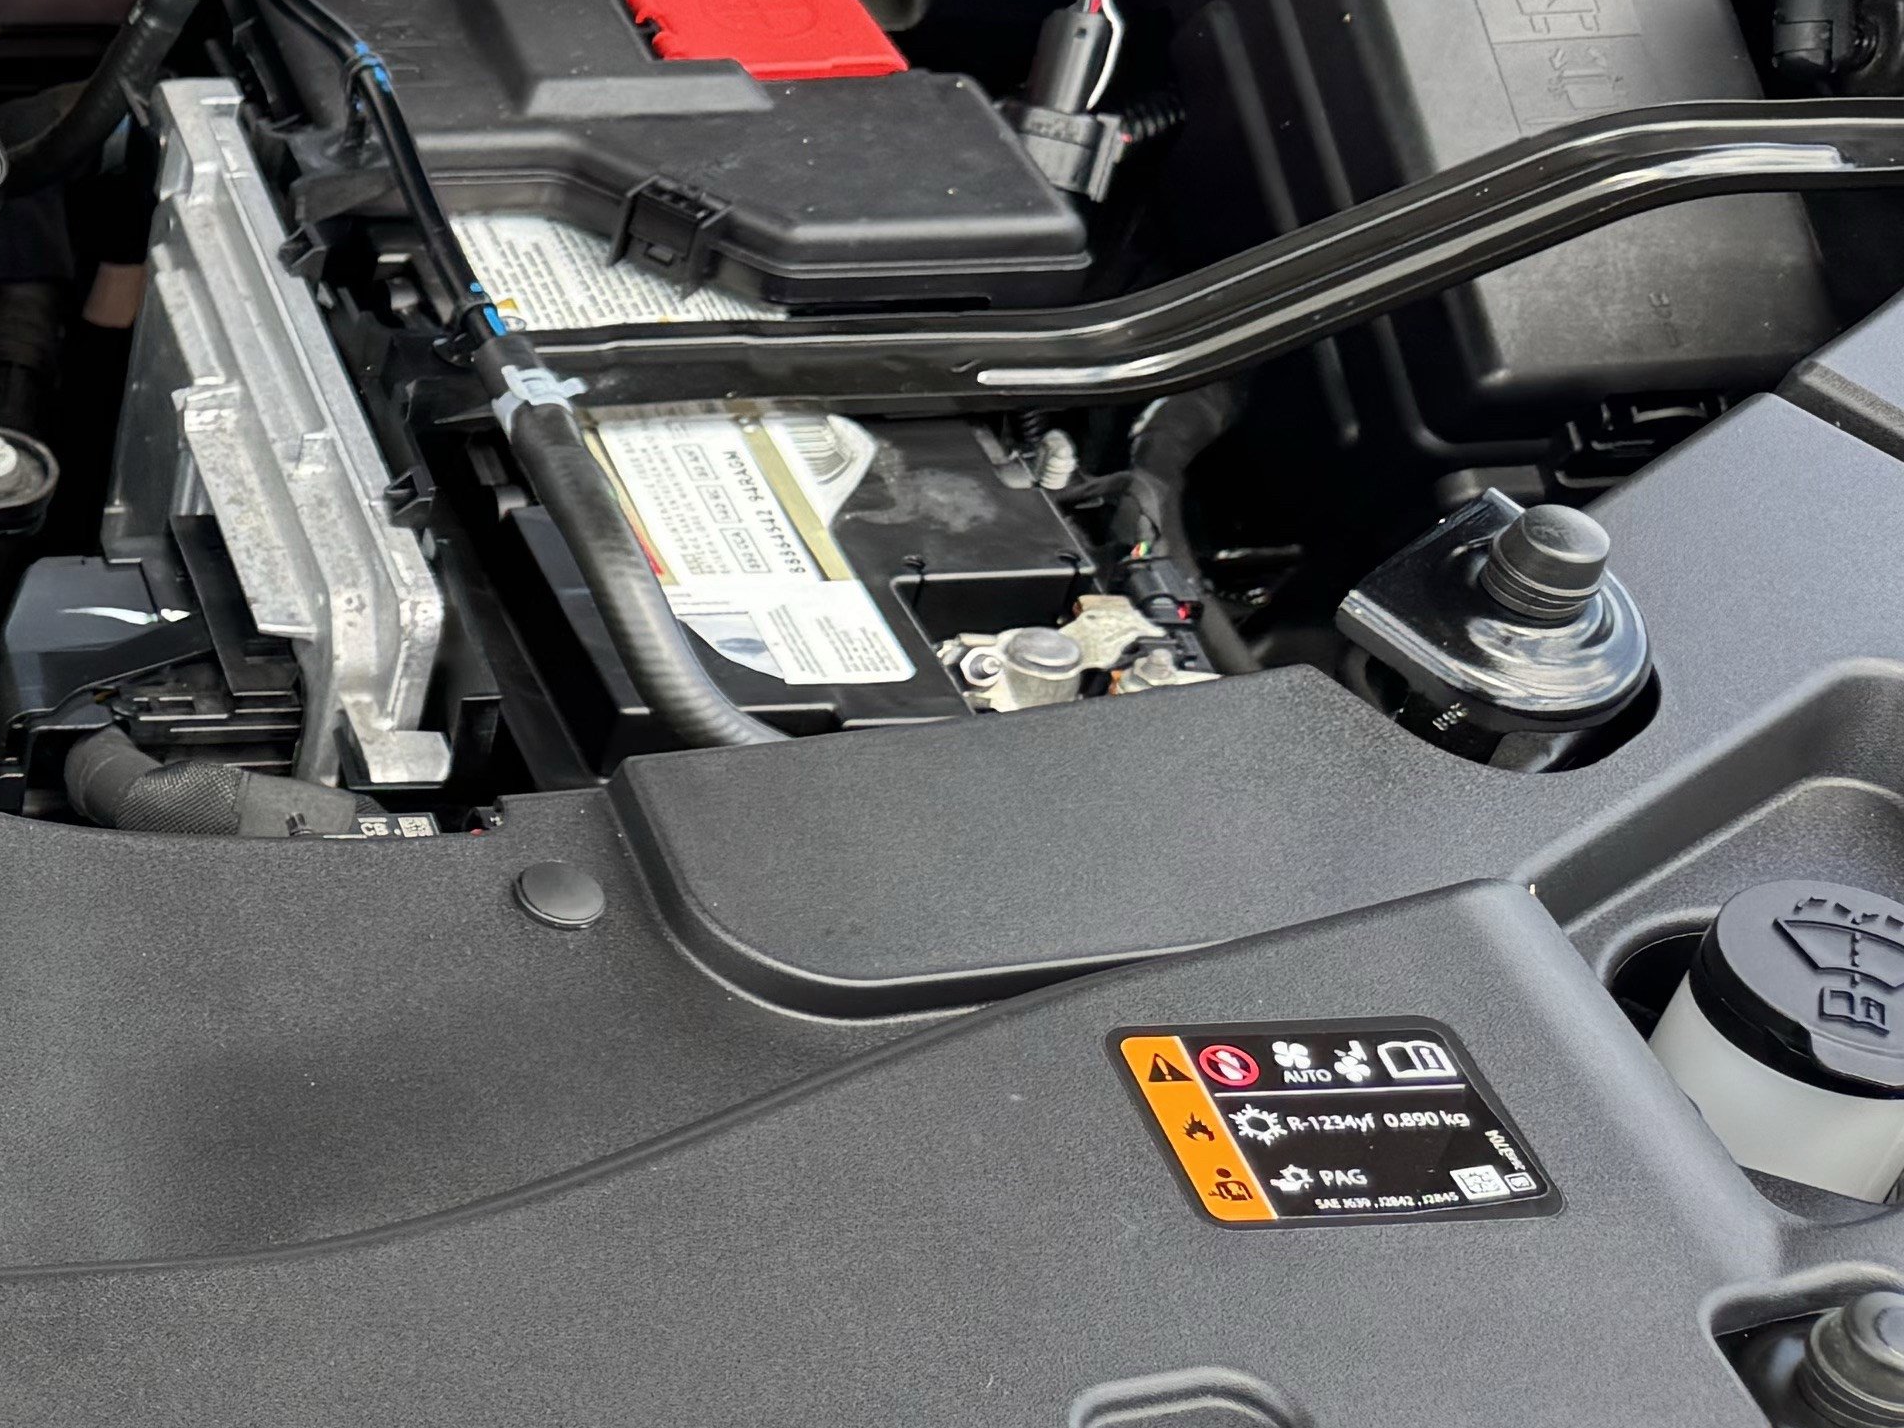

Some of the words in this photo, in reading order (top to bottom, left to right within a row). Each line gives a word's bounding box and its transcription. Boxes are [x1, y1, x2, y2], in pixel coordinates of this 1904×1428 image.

[1283, 1068, 1332, 1084] AUTO
[1287, 1113, 1376, 1134] R-1234yf
[1383, 1112, 1440, 1129] 0.890
[1440, 1110, 1470, 1129] kg
[1319, 1169, 1368, 1187] PAG
[1315, 1198, 1340, 1209] SAE
